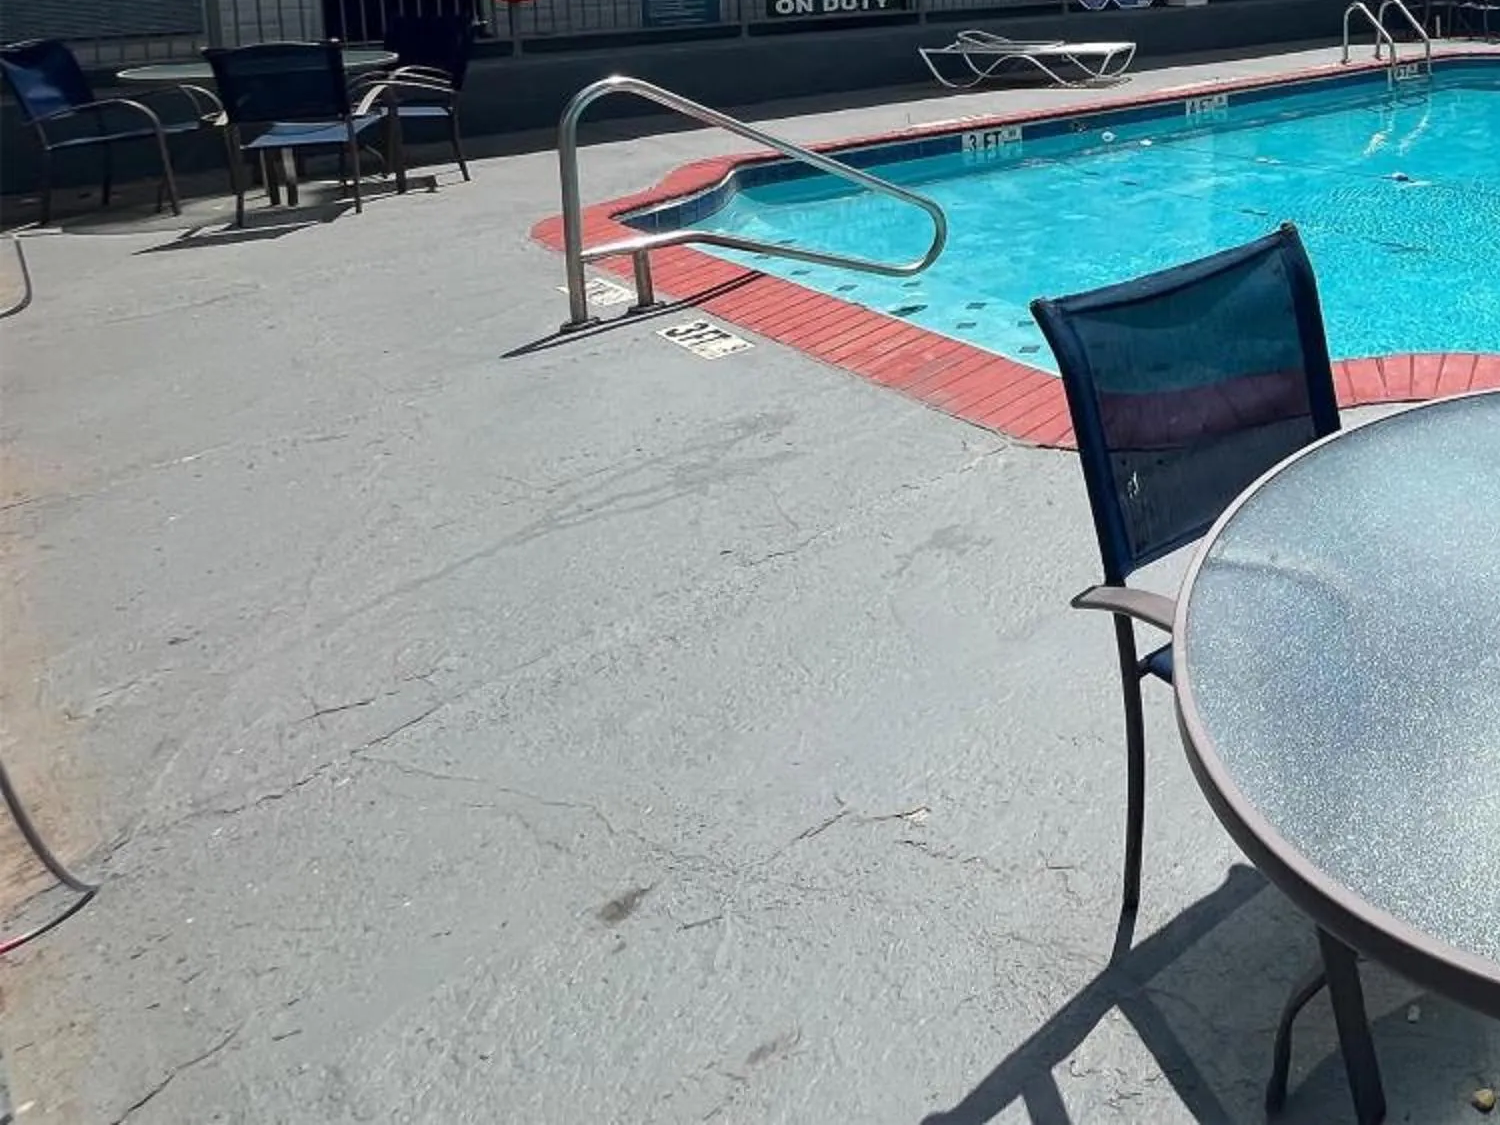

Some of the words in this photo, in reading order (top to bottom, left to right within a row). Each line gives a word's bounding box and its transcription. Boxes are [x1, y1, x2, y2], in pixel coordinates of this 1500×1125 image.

[969, 134, 977, 151] 3
[984, 130, 1002, 150] FT
[665, 322, 709, 337] 3
[678, 329, 732, 347] FT
